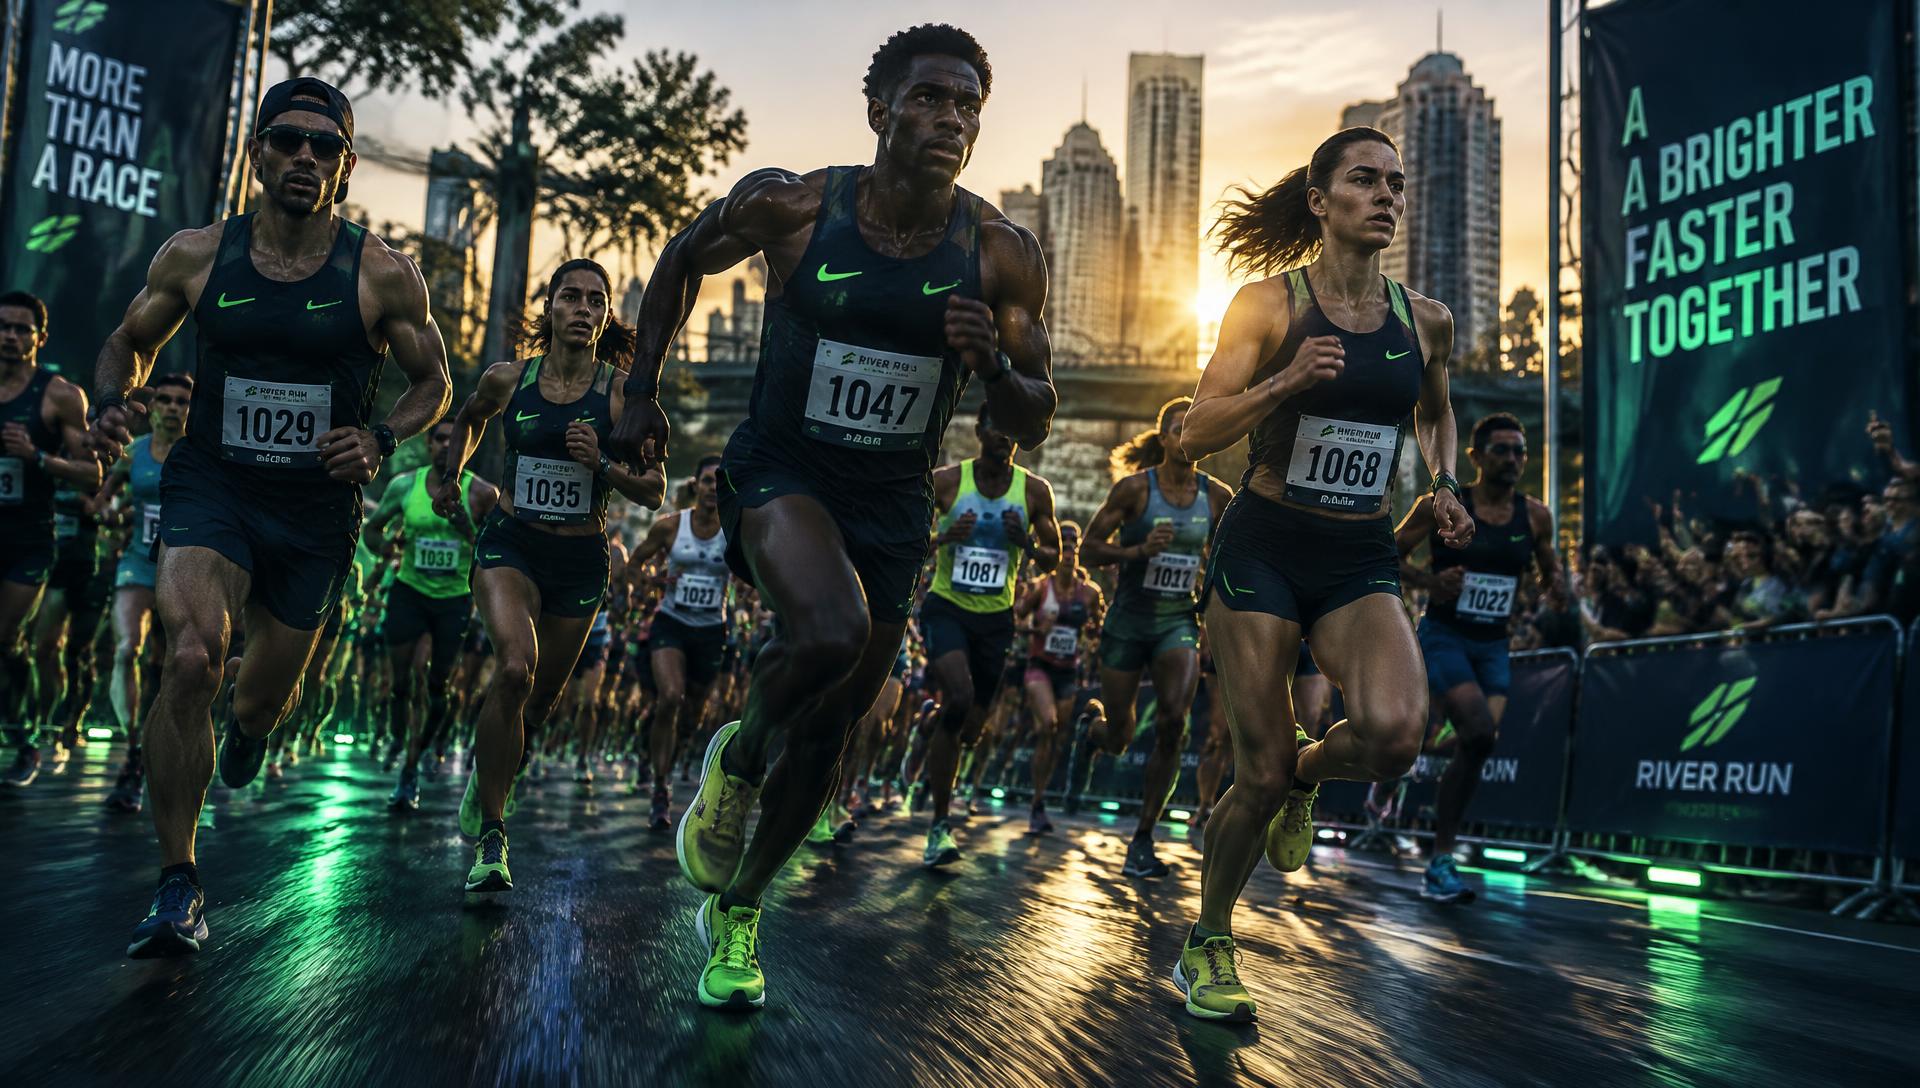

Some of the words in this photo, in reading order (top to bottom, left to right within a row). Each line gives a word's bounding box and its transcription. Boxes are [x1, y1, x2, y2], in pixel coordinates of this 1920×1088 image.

[46, 41, 147, 113] MORE
[45, 91, 142, 160] THAN
[1622, 86, 1648, 147] A
[1621, 156, 1648, 217] A
[1659, 74, 1876, 204] BRIGHTER
[32, 144, 59, 193] A
[67, 151, 163, 218] RACE
[1625, 181, 1795, 290] FASTER
[1623, 245, 1862, 363] TOGETHER
[858, 355, 890, 370] RIVER
[237, 406, 315, 446] 1029
[826, 375, 920, 425] 1047
[526, 477, 581, 508] 1035
[1306, 445, 1382, 488] 1068
[1468, 588, 1509, 612] 1022
[1635, 759, 1719, 793] RIVER
[1723, 761, 1793, 796] RUN
